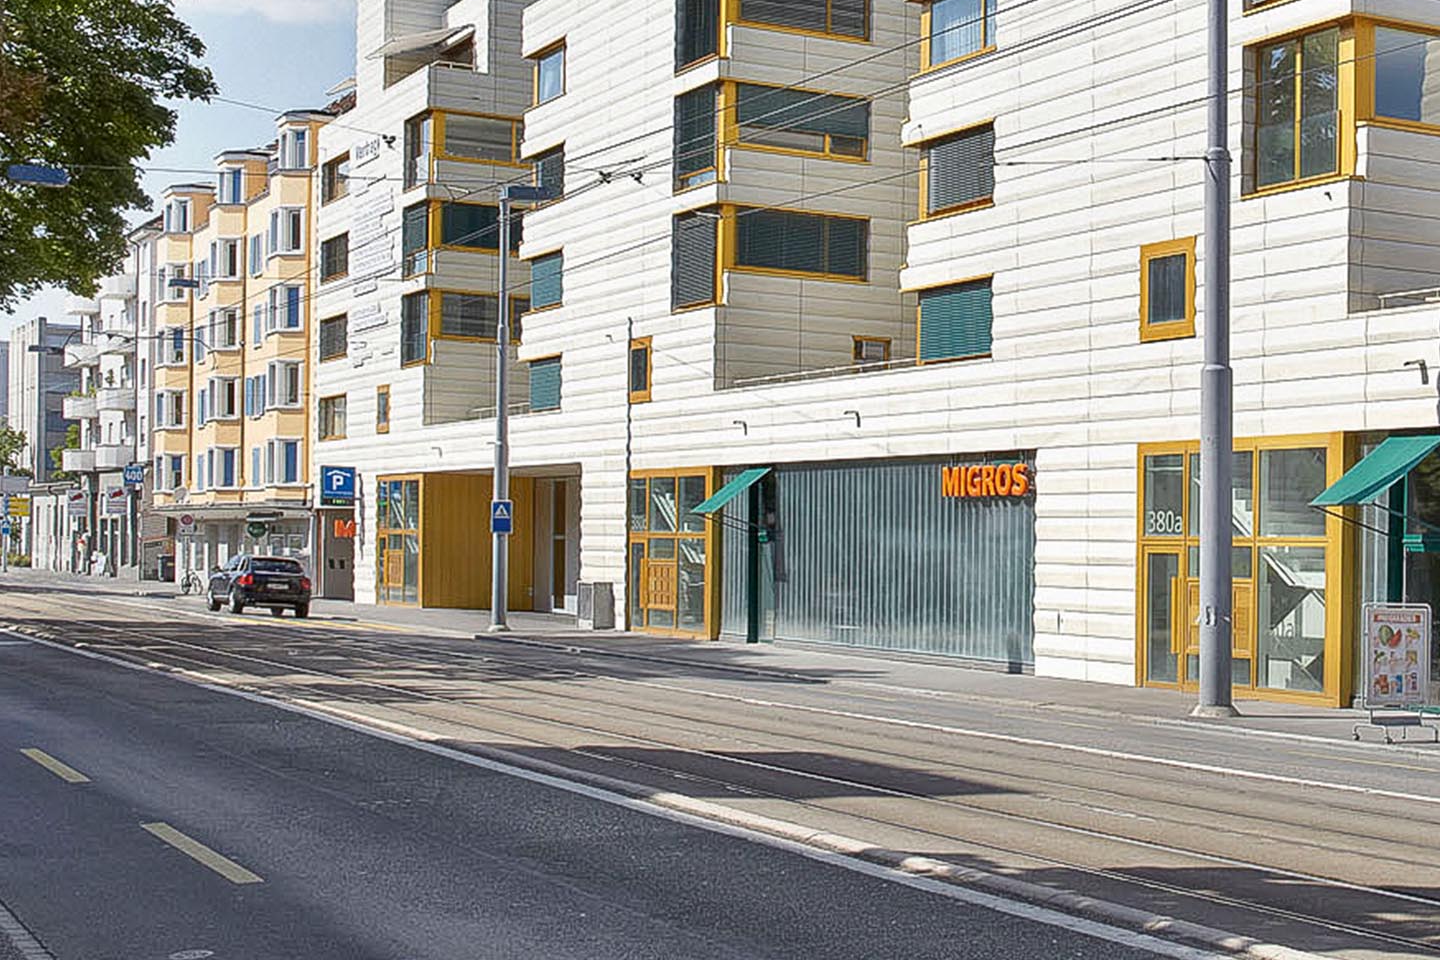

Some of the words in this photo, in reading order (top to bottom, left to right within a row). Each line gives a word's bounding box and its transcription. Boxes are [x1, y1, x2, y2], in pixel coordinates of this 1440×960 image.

[332, 474, 344, 491] P
[942, 463, 1029, 497] MIGROS
[1147, 510, 1182, 533] 380a
